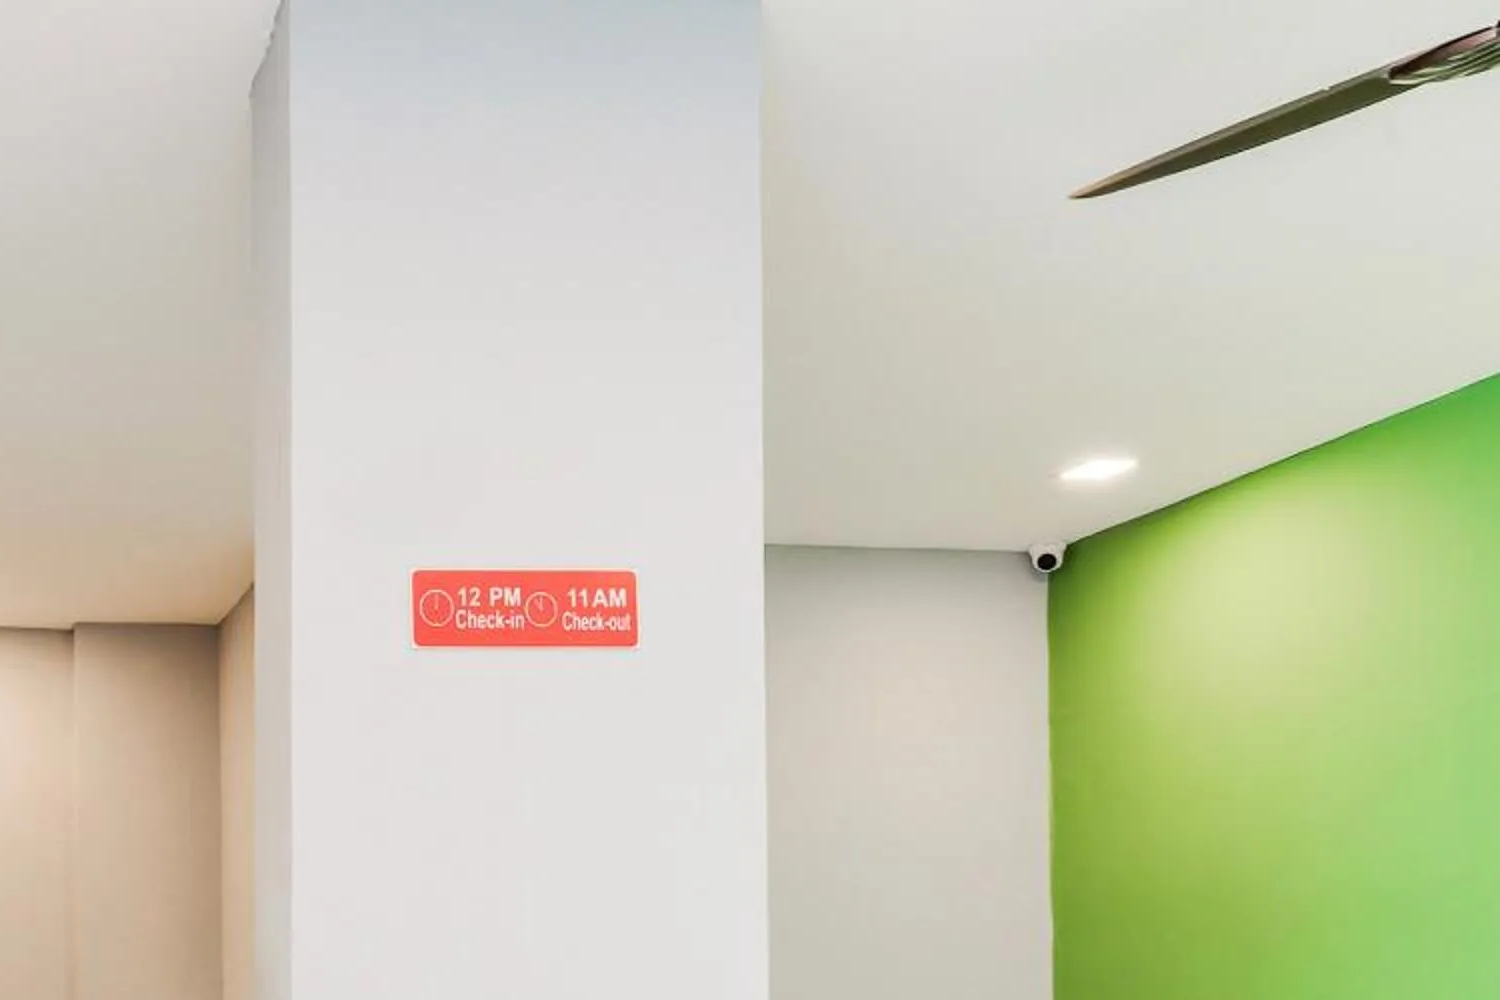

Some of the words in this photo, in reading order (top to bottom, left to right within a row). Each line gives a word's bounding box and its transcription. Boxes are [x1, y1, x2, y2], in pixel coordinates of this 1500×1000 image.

[457, 587, 481, 607] 12
[489, 587, 522, 607] PM
[455, 610, 525, 630] Check-in
[562, 611, 632, 631] Check-out
